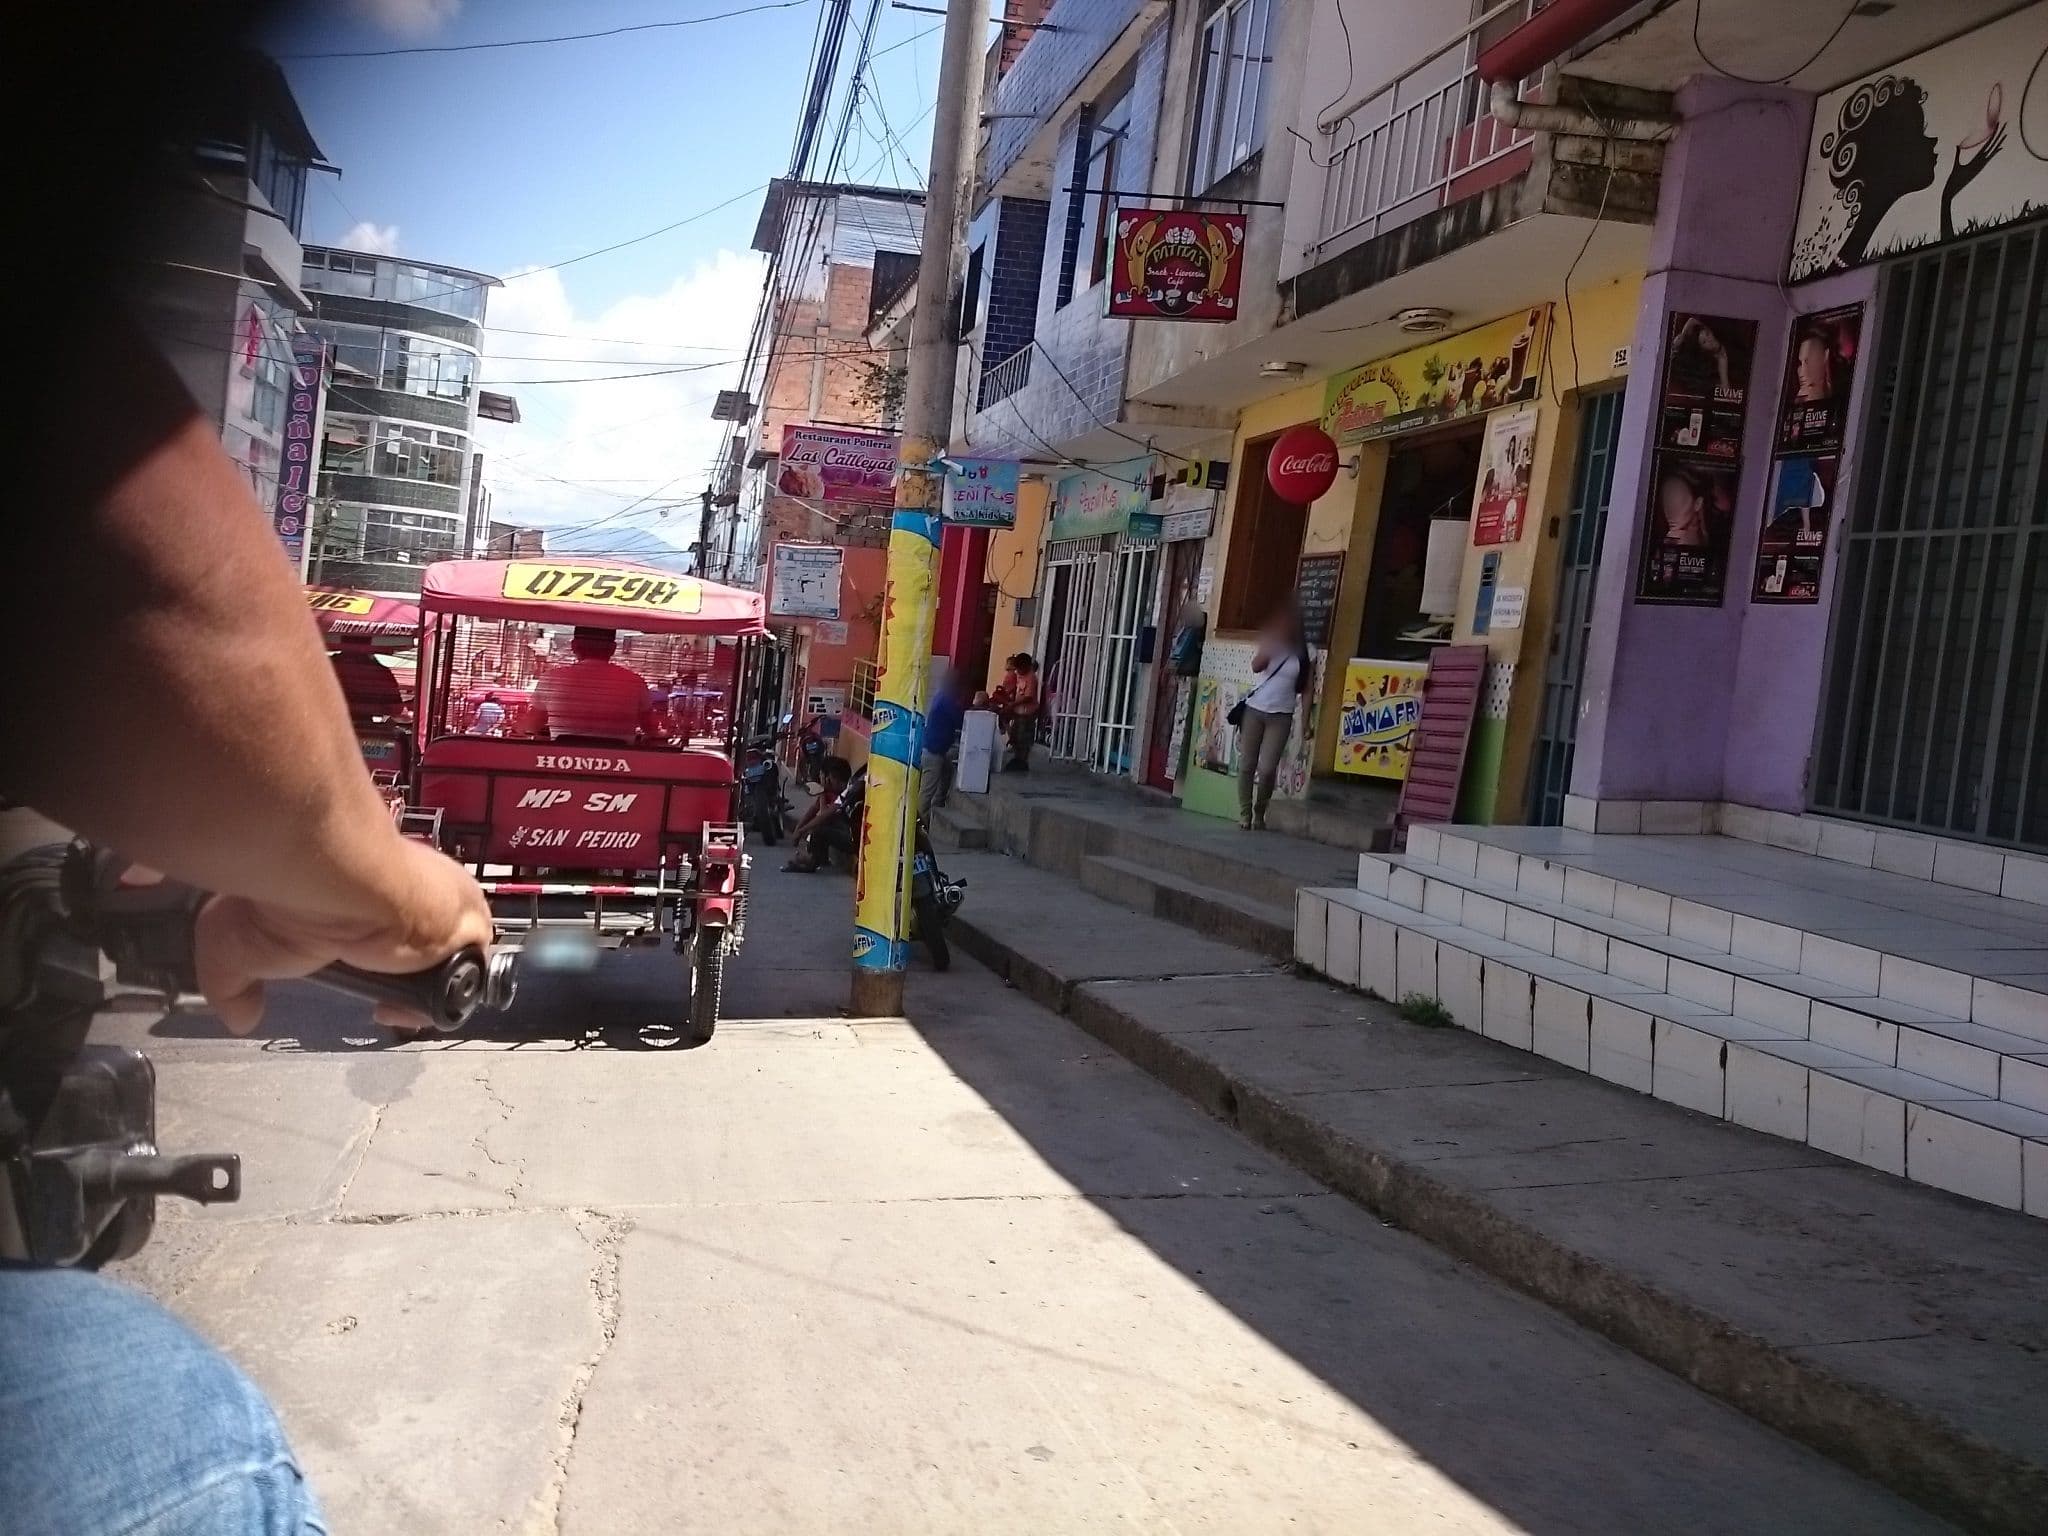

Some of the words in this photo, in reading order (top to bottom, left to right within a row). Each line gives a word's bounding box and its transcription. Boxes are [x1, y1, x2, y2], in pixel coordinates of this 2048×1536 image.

[1714, 387, 1744, 399] ELVIVE
[795, 431, 851, 445] Restaurant
[280, 366, 318, 536] pañales
[788, 444, 819, 463] Las
[823, 447, 896, 472] Cattleyas
[1796, 530, 1823, 541] ELVIVE
[1680, 556, 1706, 567] ELVIVE
[525, 569, 680, 604] 07598
[536, 755, 631, 772] HONDA
[516, 788, 572, 809] MP
[583, 792, 638, 813] SM
[526, 828, 571, 847] SAN
[576, 830, 642, 849] PEDRO
